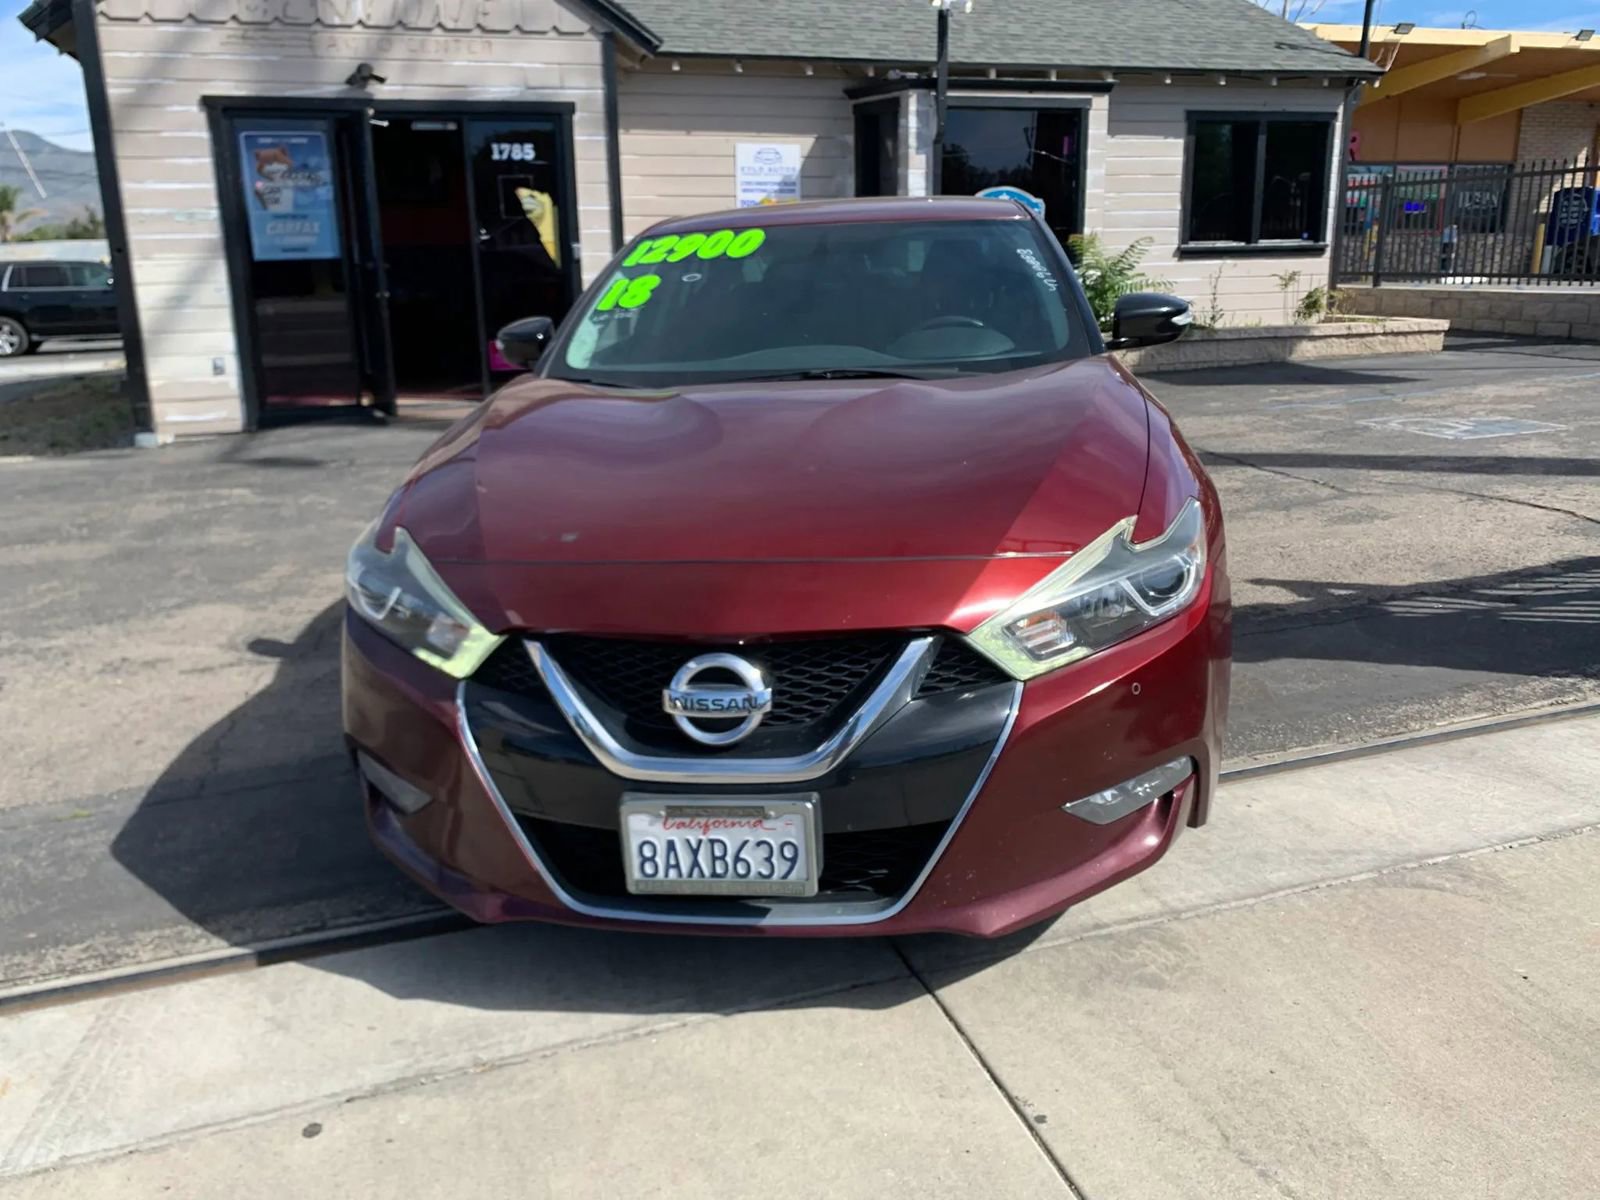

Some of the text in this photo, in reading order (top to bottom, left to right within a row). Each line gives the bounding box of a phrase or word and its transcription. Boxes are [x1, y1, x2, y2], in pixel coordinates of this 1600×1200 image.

[490, 143, 536, 161] 1785
[621, 228, 766, 267] 12900
[596, 274, 662, 311] 18
[672, 695, 759, 712] NISSAN
[661, 815, 777, 835] California
[638, 837, 799, 880] 8AXB639
